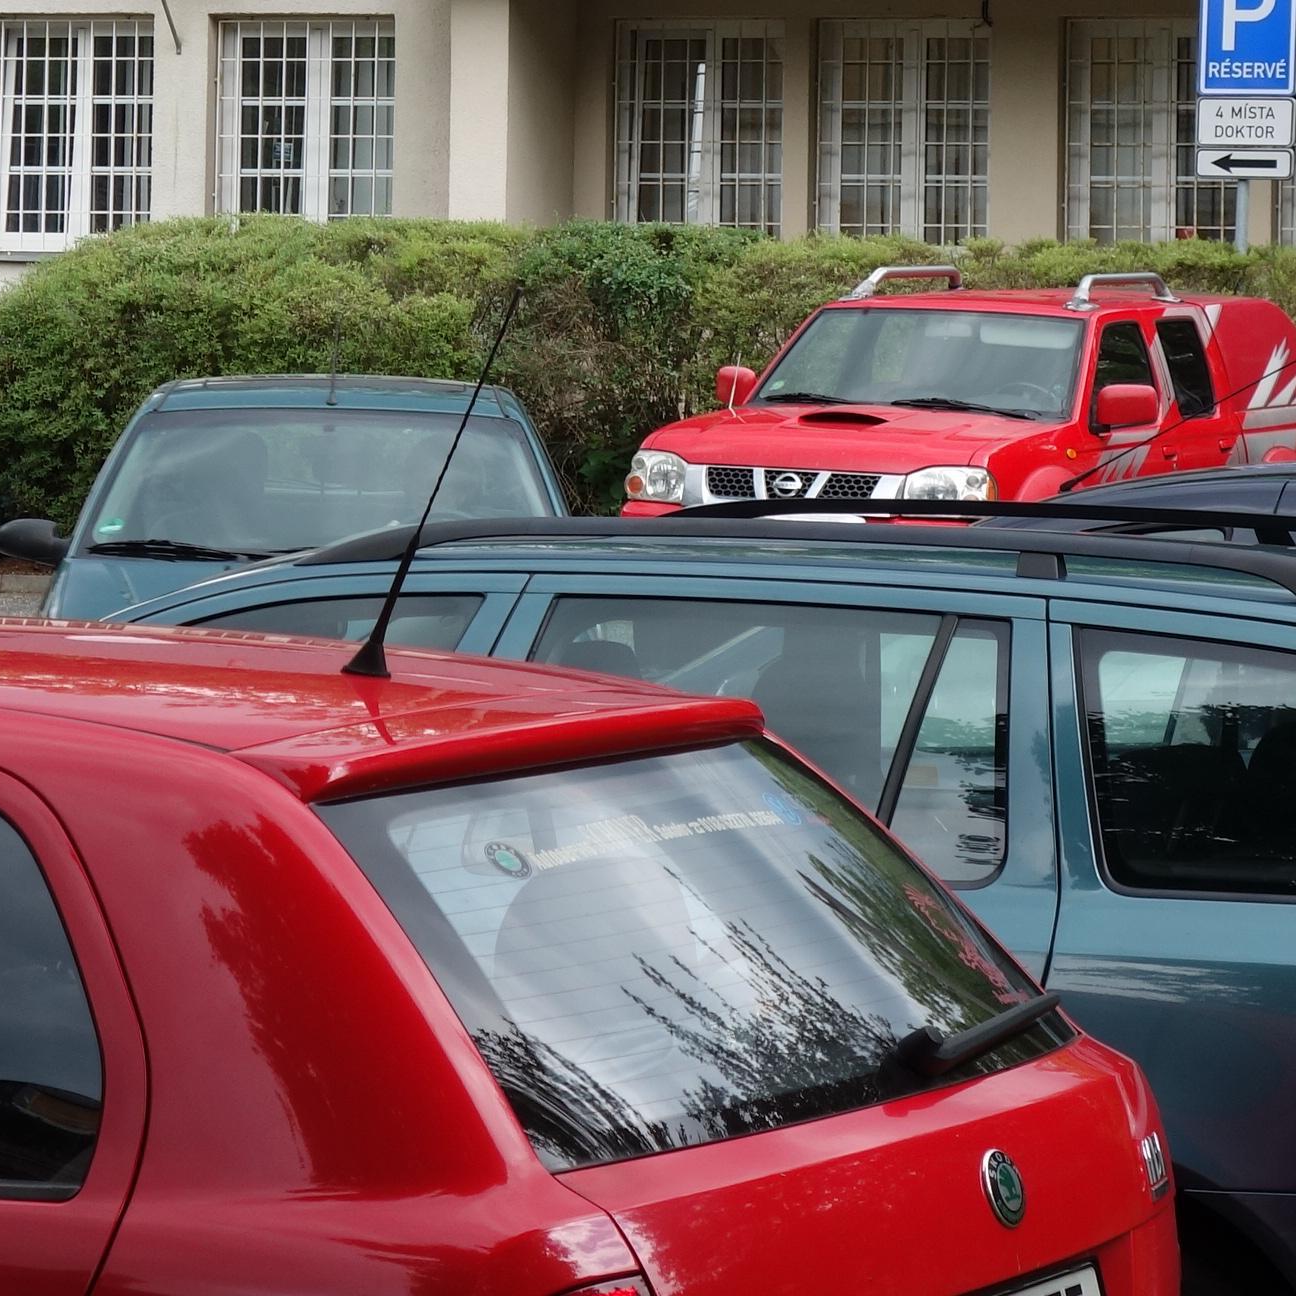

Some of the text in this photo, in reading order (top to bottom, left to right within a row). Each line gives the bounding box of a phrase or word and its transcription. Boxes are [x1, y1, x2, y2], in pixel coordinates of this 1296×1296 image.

[1208, 59, 1286, 79] RÉSERVÉ
[1215, 103, 1276, 119] 4 MÍSTA
[1214, 125, 1275, 139] DOKTOR
